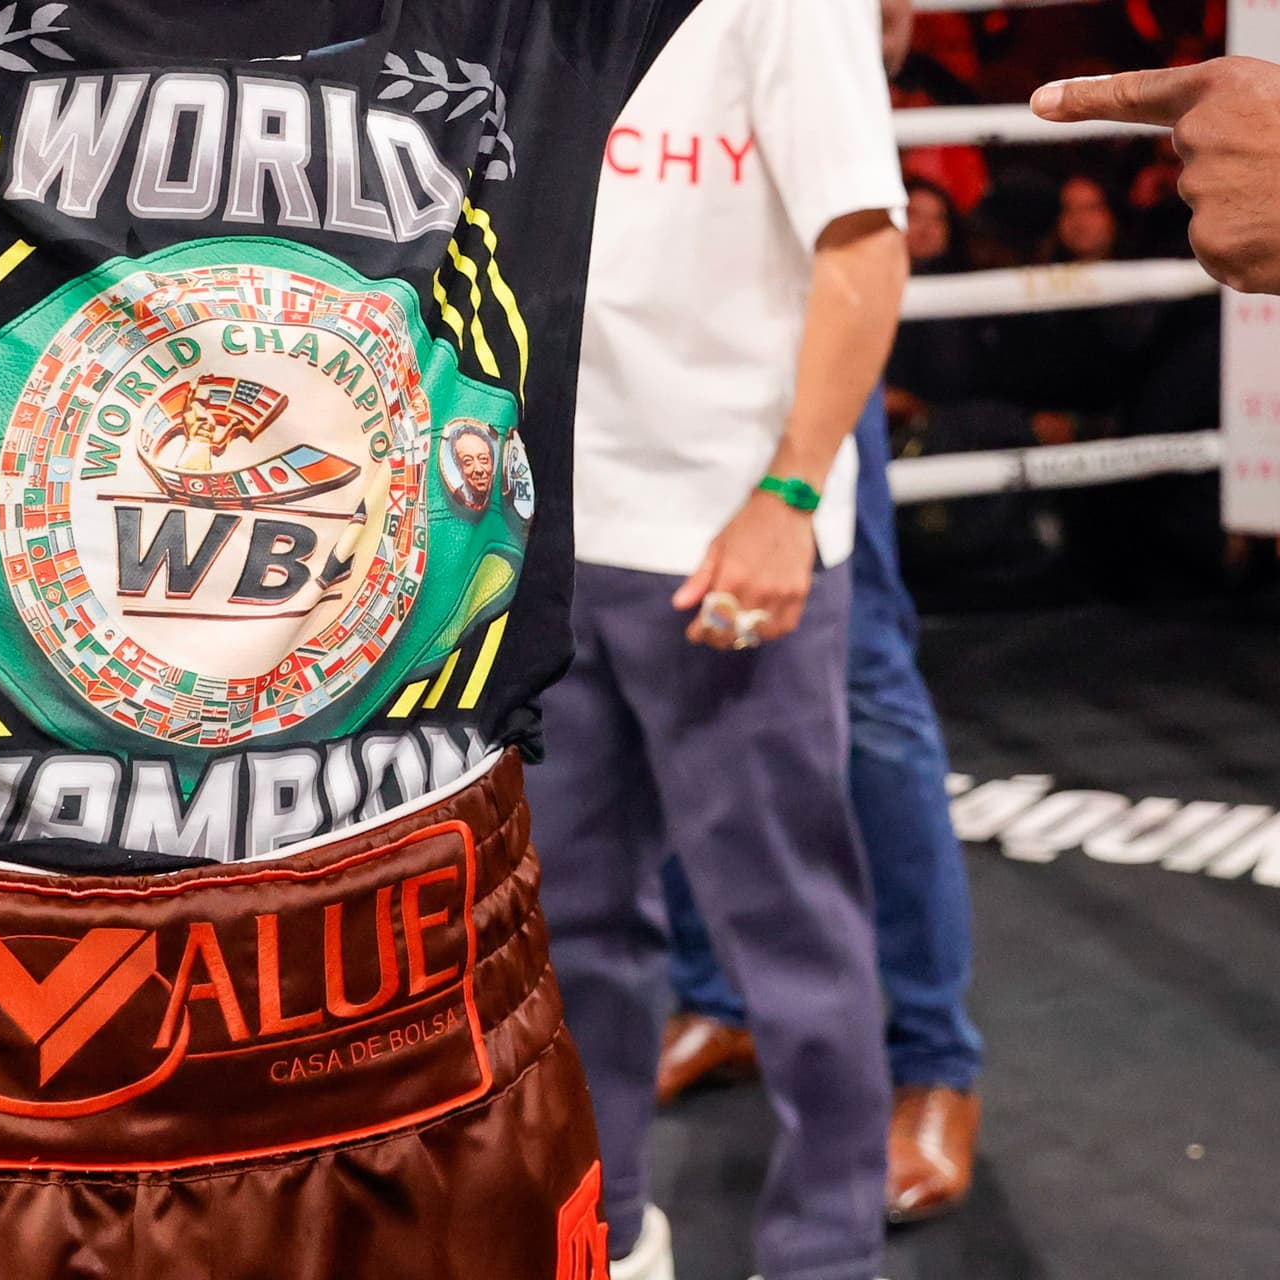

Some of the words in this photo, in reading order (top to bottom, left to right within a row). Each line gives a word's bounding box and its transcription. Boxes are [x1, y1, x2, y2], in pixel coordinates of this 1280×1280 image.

[4, 73, 464, 243] WORLD
[606, 126, 757, 186] CHY
[80, 336, 202, 480] WORLD
[114, 505, 358, 606] WB
[271, 1048, 343, 1083] CASA
[350, 1035, 384, 1065] DE
[389, 1007, 459, 1052] BOLSA
